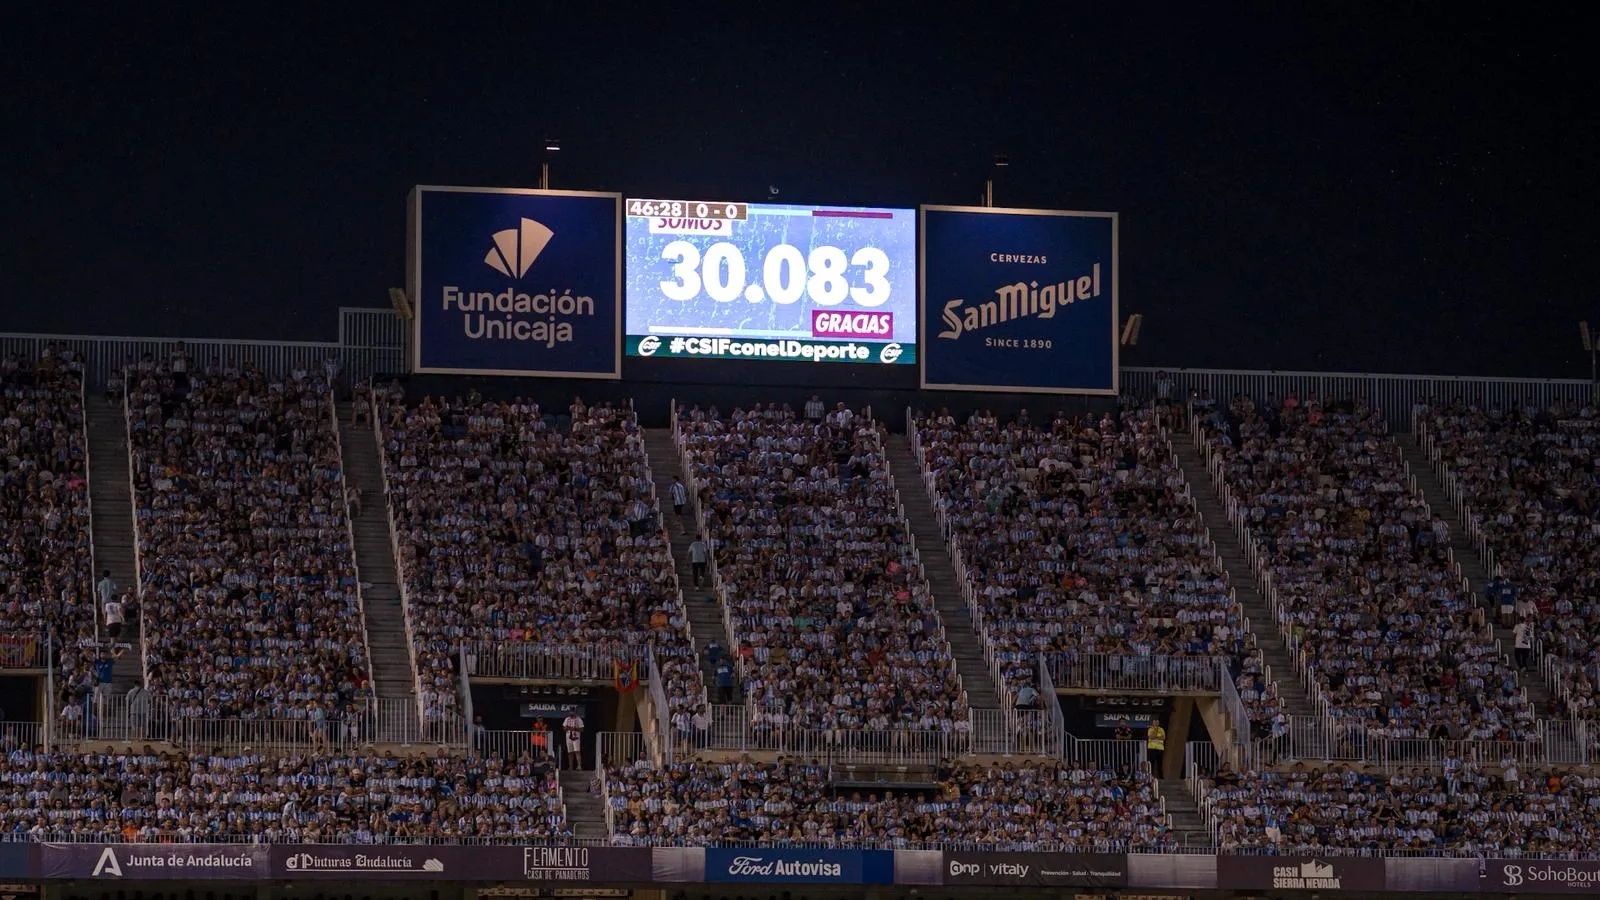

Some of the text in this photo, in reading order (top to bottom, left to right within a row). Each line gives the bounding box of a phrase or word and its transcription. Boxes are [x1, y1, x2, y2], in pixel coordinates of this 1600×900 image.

[630, 201, 682, 216] 46:28
[696, 203, 708, 217] 0
[725, 204, 737, 218] 0
[990, 252, 1047, 264] CERVEZAS
[660, 240, 891, 307] 30.083
[442, 286, 594, 315] Fundación
[815, 312, 890, 335] GRACIAS
[464, 314, 573, 349] Unicaja
[669, 337, 870, 361] #CSIFconelDeporte
[985, 337, 1052, 349] SINCE 1890
[528, 703, 556, 711] SALIDA
[126, 853, 252, 867] Junta de Andalucía
[523, 847, 589, 875] FERMENTO
[728, 856, 841, 876] Ford Autovisa
[527, 870, 590, 880] CASA DE PANADEROS
[989, 862, 1029, 878] vitaly
[1273, 866, 1299, 877] CASH
[1273, 877, 1341, 889] SIERRA NEVADA
